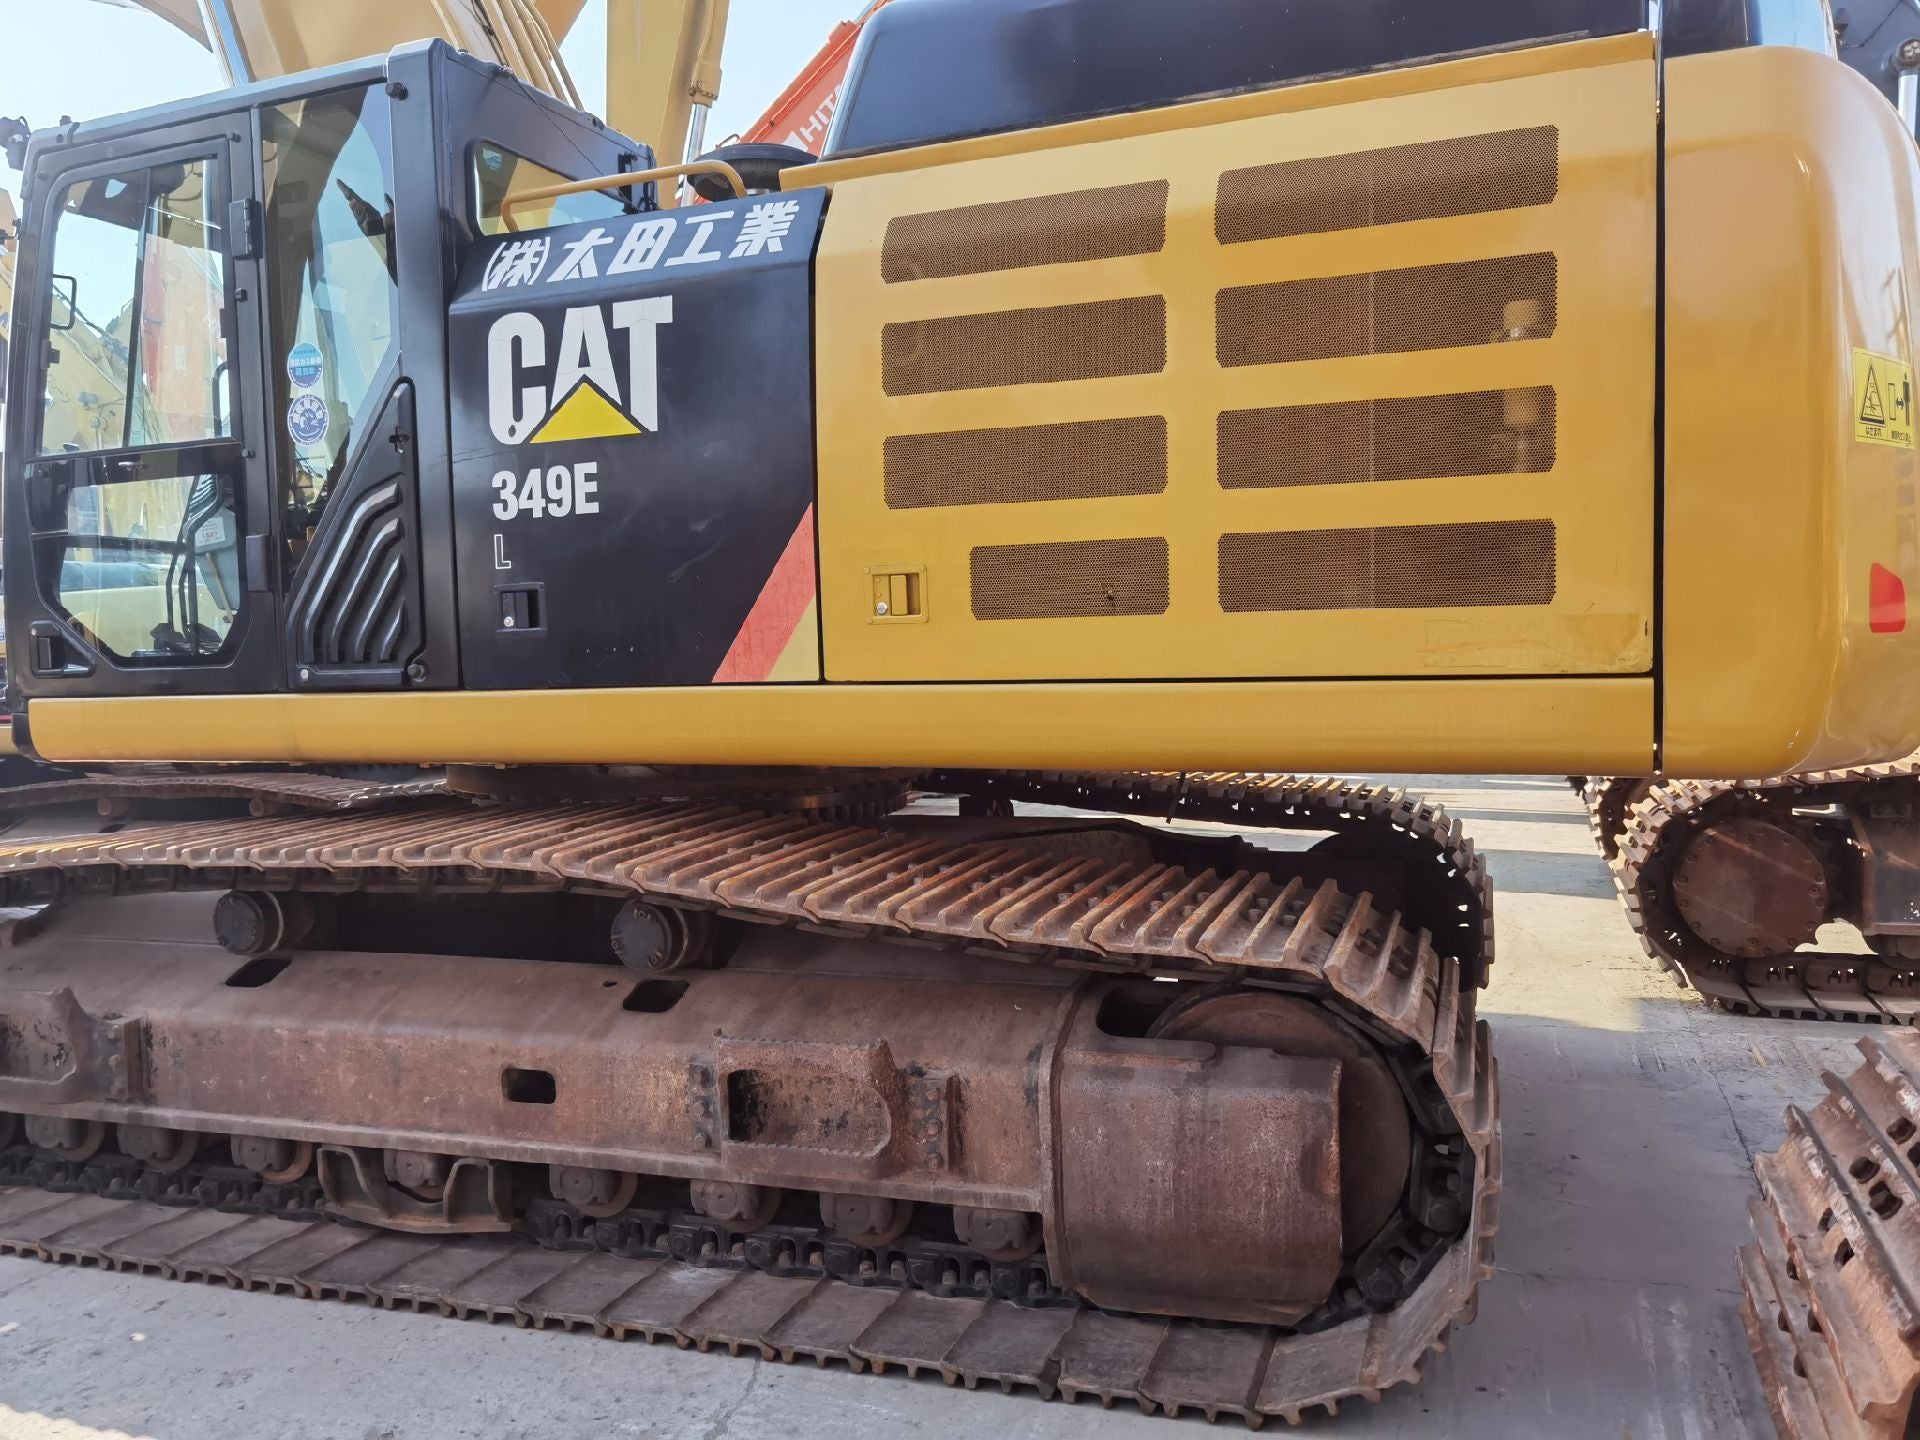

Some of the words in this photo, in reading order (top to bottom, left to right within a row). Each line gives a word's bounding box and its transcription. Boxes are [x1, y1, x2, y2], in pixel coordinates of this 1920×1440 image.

[488, 295, 673, 445] CAT
[492, 461, 599, 520] 349E
[494, 534, 512, 570] L
